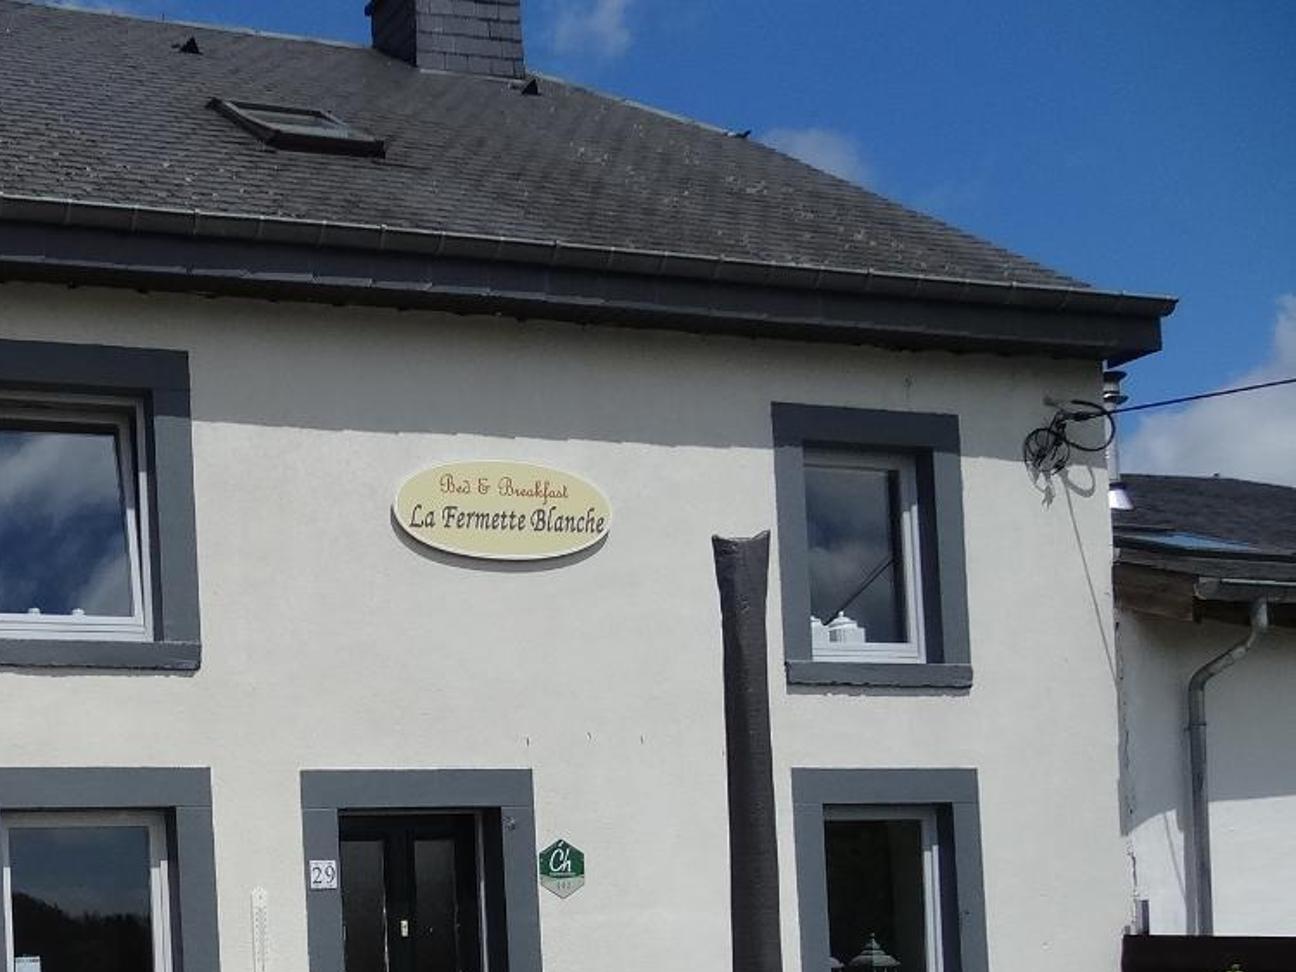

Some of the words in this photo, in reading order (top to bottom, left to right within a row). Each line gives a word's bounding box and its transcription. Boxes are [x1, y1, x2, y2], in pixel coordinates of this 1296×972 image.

[439, 473, 471, 495] Bed
[477, 478, 491, 495] &
[497, 476, 570, 505] Breakfast
[409, 503, 435, 529] La
[441, 505, 527, 532] Fermette
[531, 507, 606, 534] Blanche
[311, 865, 337, 885] 29
